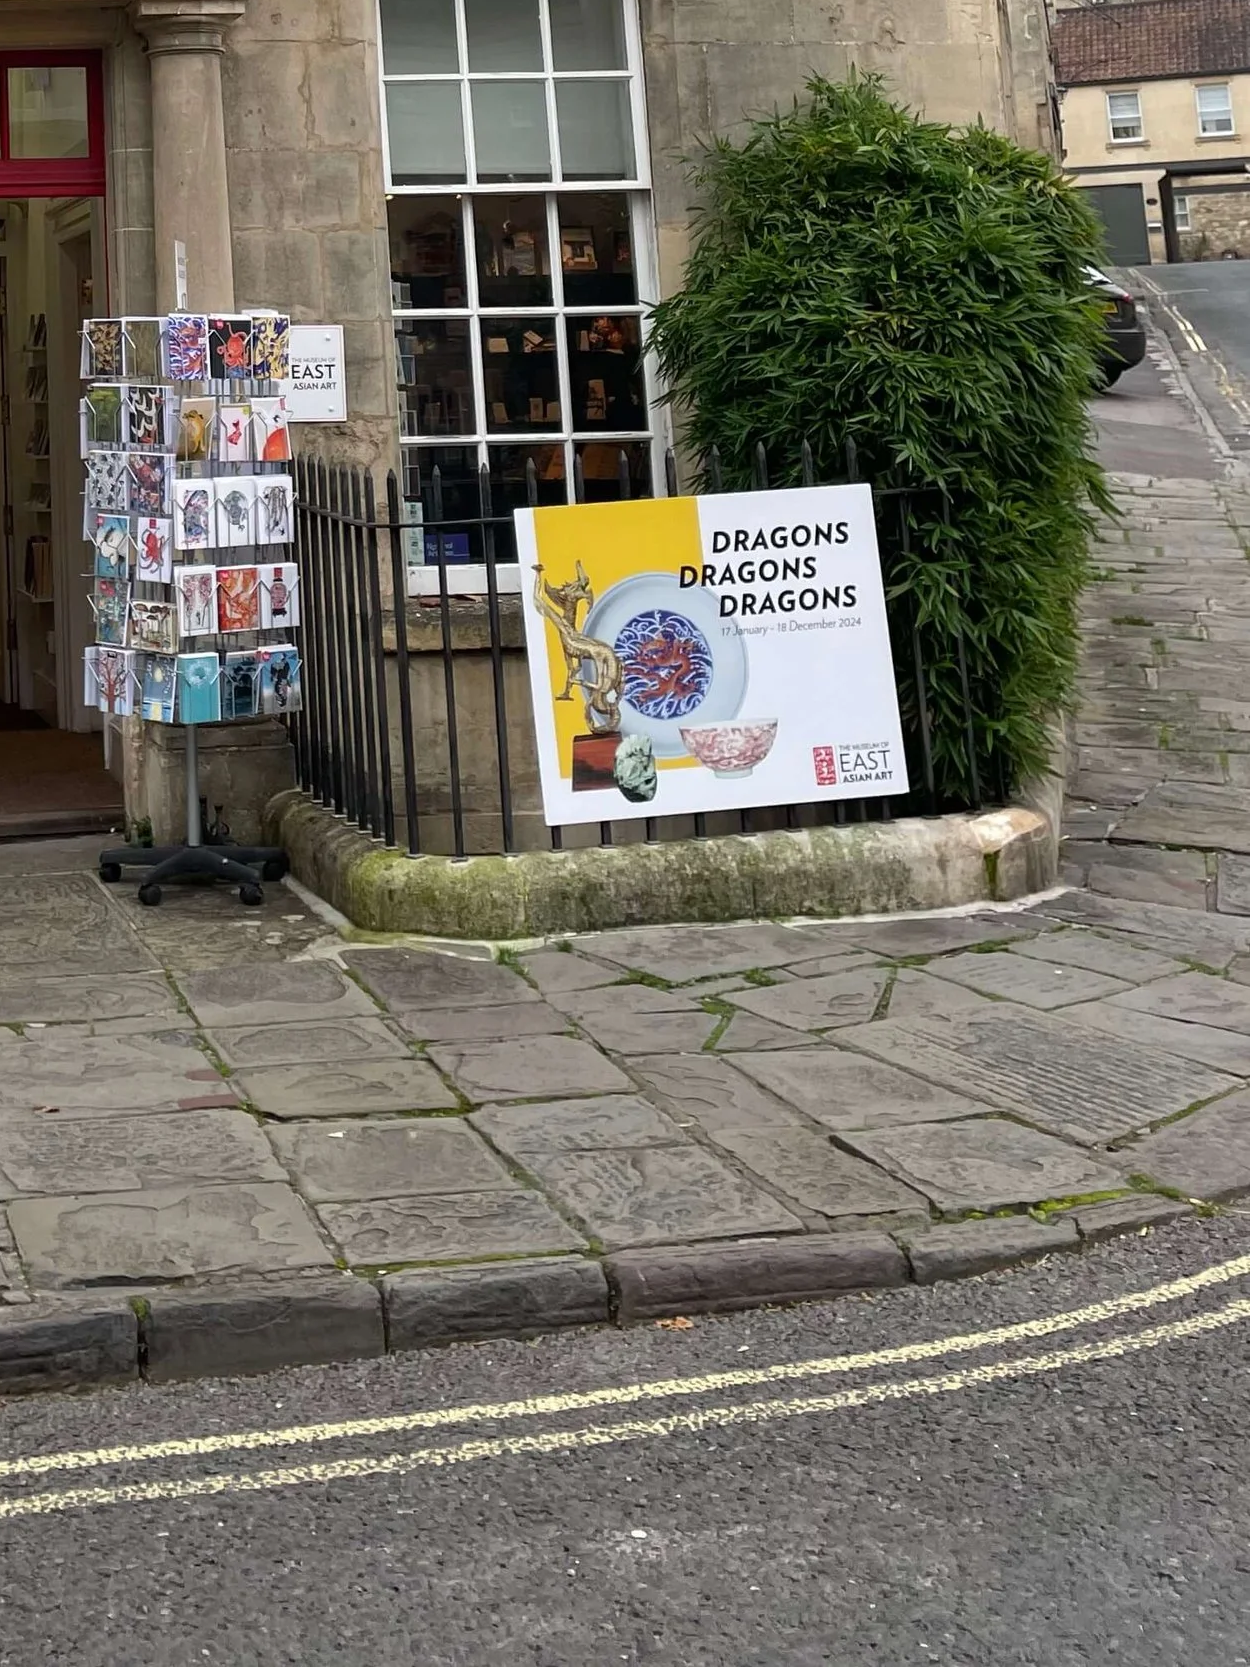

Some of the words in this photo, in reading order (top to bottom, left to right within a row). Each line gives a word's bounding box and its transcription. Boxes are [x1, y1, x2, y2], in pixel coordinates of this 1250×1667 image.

[291, 364, 336, 379] EAST
[293, 382, 319, 390] ASIAN
[320, 381, 337, 390] ART
[712, 521, 849, 554] DRAGONS
[679, 556, 817, 589] DRAGONS
[719, 585, 857, 618] DRAGONS
[722, 626, 731, 636] 17
[732, 624, 768, 637] January
[778, 622, 787, 632] 18
[789, 619, 837, 632] December
[838, 617, 862, 627] 2024
[840, 750, 890, 772] EAST
[843, 772, 872, 783] ASIAN
[874, 771, 893, 781] ART
